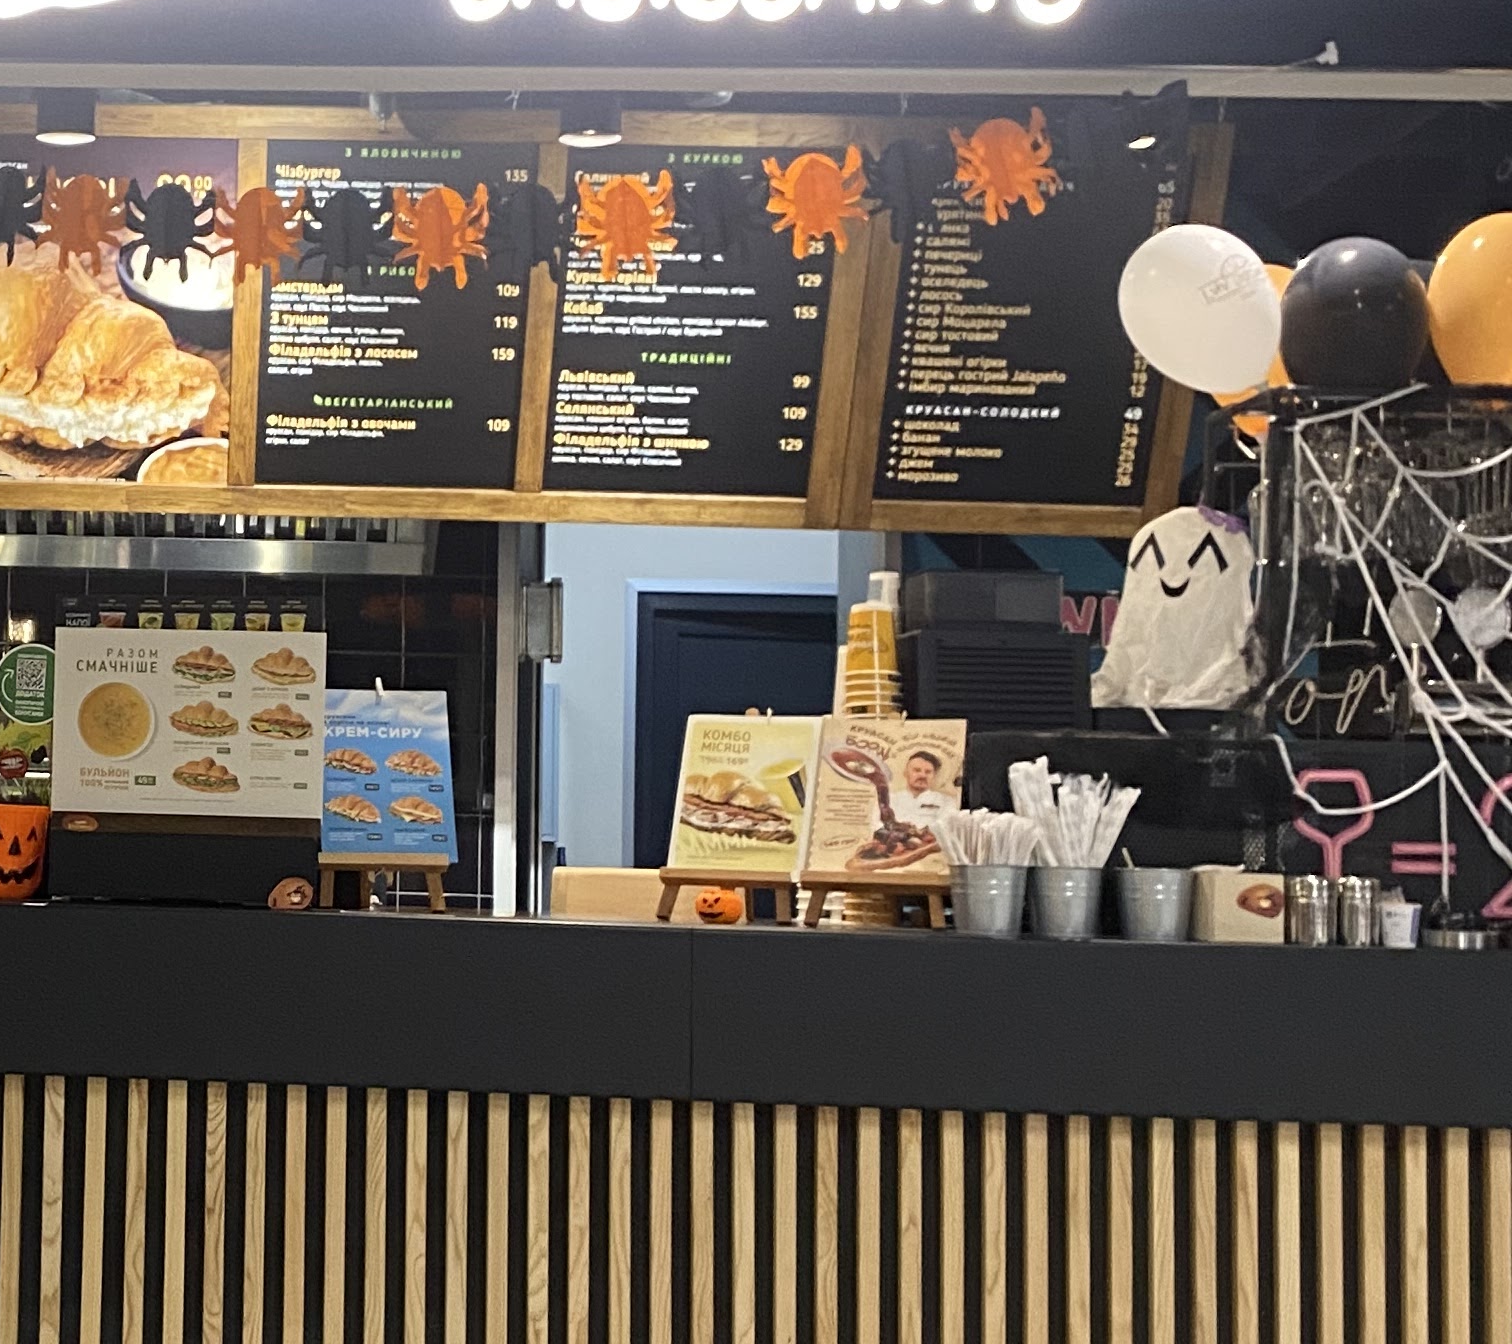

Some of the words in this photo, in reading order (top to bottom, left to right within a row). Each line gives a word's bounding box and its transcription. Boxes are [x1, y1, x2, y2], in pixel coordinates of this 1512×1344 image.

[360, 148, 461, 159] ЯЛОВИЧИНОЮ
[683, 153, 744, 164] КУРКОЮ
[275, 165, 341, 180] Чізбургер
[504, 170, 528, 183] 135
[924, 250, 982, 262] печериці
[922, 264, 968, 276] тунець
[797, 274, 822, 287] 129
[496, 284, 519, 297] 109
[564, 301, 604, 315] Кебаб
[794, 306, 818, 320] 155
[918, 304, 941, 316] сир
[945, 302, 1030, 316] Королівський
[270, 312, 279, 324] З
[283, 314, 328, 326] тунцем
[494, 316, 517, 329] 119
[916, 317, 939, 329] сир
[943, 316, 1007, 330] Моцарела
[915, 330, 937, 342] сир
[941, 330, 999, 342] тостовий
[269, 343, 351, 358] Філадельфія
[355, 349, 361, 357] з
[365, 348, 418, 359] лососем
[491, 348, 515, 361] 159
[641, 352, 732, 365] ТРАДИЦІЙНІ
[558, 370, 636, 384] Львівський
[792, 375, 811, 388] 99
[959, 371, 1008, 383] гострий
[324, 395, 453, 409] ВЕГЕТАРІАНСЬКИЙ
[556, 402, 634, 416] Селянський
[782, 408, 806, 420] 109
[905, 405, 1060, 419] КРУАСАН-СОЛОДКИЙ
[267, 415, 348, 429] Філадельфія
[352, 420, 358, 429] з
[362, 419, 416, 430] овочами
[487, 419, 511, 431] 109
[903, 420, 961, 432] шоколад
[554, 434, 639, 448] Філадельфія
[654, 438, 710, 450] шинкою
[778, 438, 804, 452] 129
[902, 432, 941, 443] банан
[955, 447, 1003, 458] молоко
[899, 458, 934, 470] джем
[897, 470, 959, 483] морозиво
[106, 648, 158, 658] РАЗОМ
[76, 660, 158, 674] СМАЧНІШЕ
[325, 726, 422, 738] КРЕМ-СИРУ
[703, 730, 751, 741] КОМБО
[701, 742, 750, 754] МІСЯЦЯ
[80, 766, 130, 777] БУЛЬЙОН
